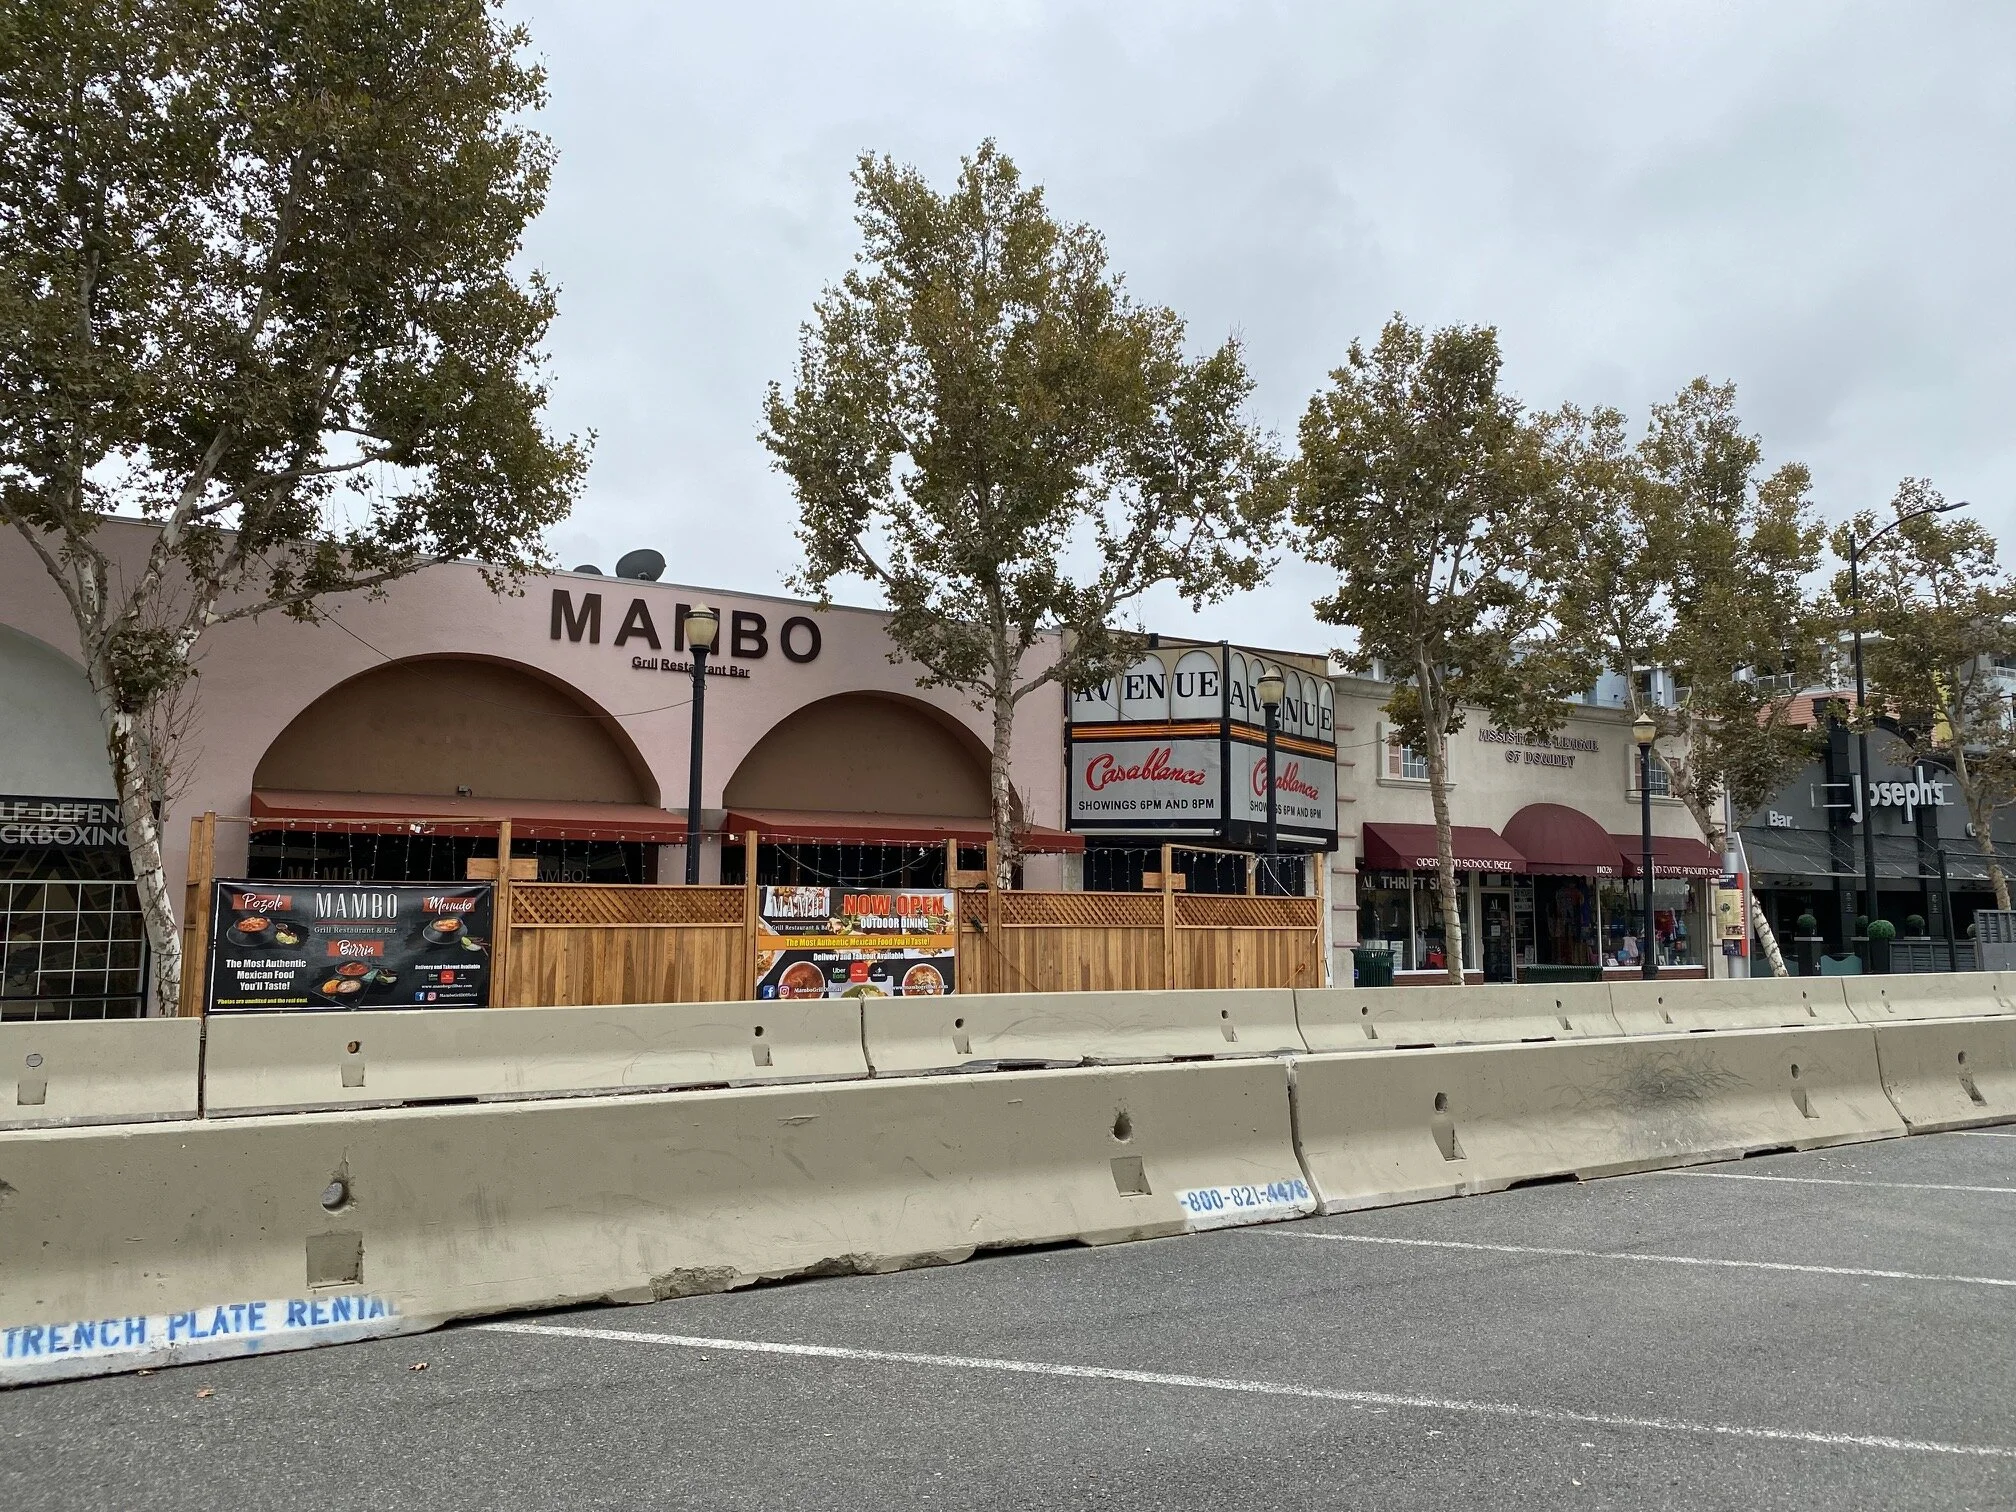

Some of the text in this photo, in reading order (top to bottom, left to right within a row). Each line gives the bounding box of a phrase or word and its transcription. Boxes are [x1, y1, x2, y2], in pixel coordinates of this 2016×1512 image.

[632, 656, 751, 679] Grill Restarant Bar
[1229, 680, 1333, 732] AVNUE
[1505, 749, 1521, 764] OF
[1252, 756, 1320, 801] Caablanca
[1078, 798, 1215, 811] SHOWINGS 6PM AND 8PM
[1283, 804, 1296, 816] 6PM
[1296, 805, 1309, 818] AND
[1309, 807, 1322, 819] 8PM
[0, 801, 125, 824] LF-DEFEN
[1494, 860, 1512, 871] BELL
[1596, 865, 1613, 874] 11026
[1682, 866, 1709, 876] AROUND
[1381, 876, 1426, 890] THRIFT
[242, 892, 284, 914] Pozole
[315, 892, 398, 919] MAMBO
[427, 895, 473, 916] Menudo
[843, 894, 945, 916] NOW OPEN
[860, 917, 930, 929] OUTDOOR DINING
[314, 926, 331, 934] Grill
[334, 926, 376, 935] Restaurant
[337, 939, 374, 957] Birria
[786, 938, 799, 947] The
[799, 938, 817, 947] Most
[817, 937, 849, 947] Authentic
[850, 937, 877, 947] Mexican
[877, 937, 894, 946] Food
[911, 937, 930, 946] Taste!
[226, 959, 307, 968] The Most Authentic
[813, 952, 904, 962] Delivery and Takeout Available
[236, 970, 295, 980] Mexican Food
[240, 981, 291, 991] You'll Taste!
[1, 1314, 146, 1359] TRENCH
[167, 1301, 267, 1341] PLATE
